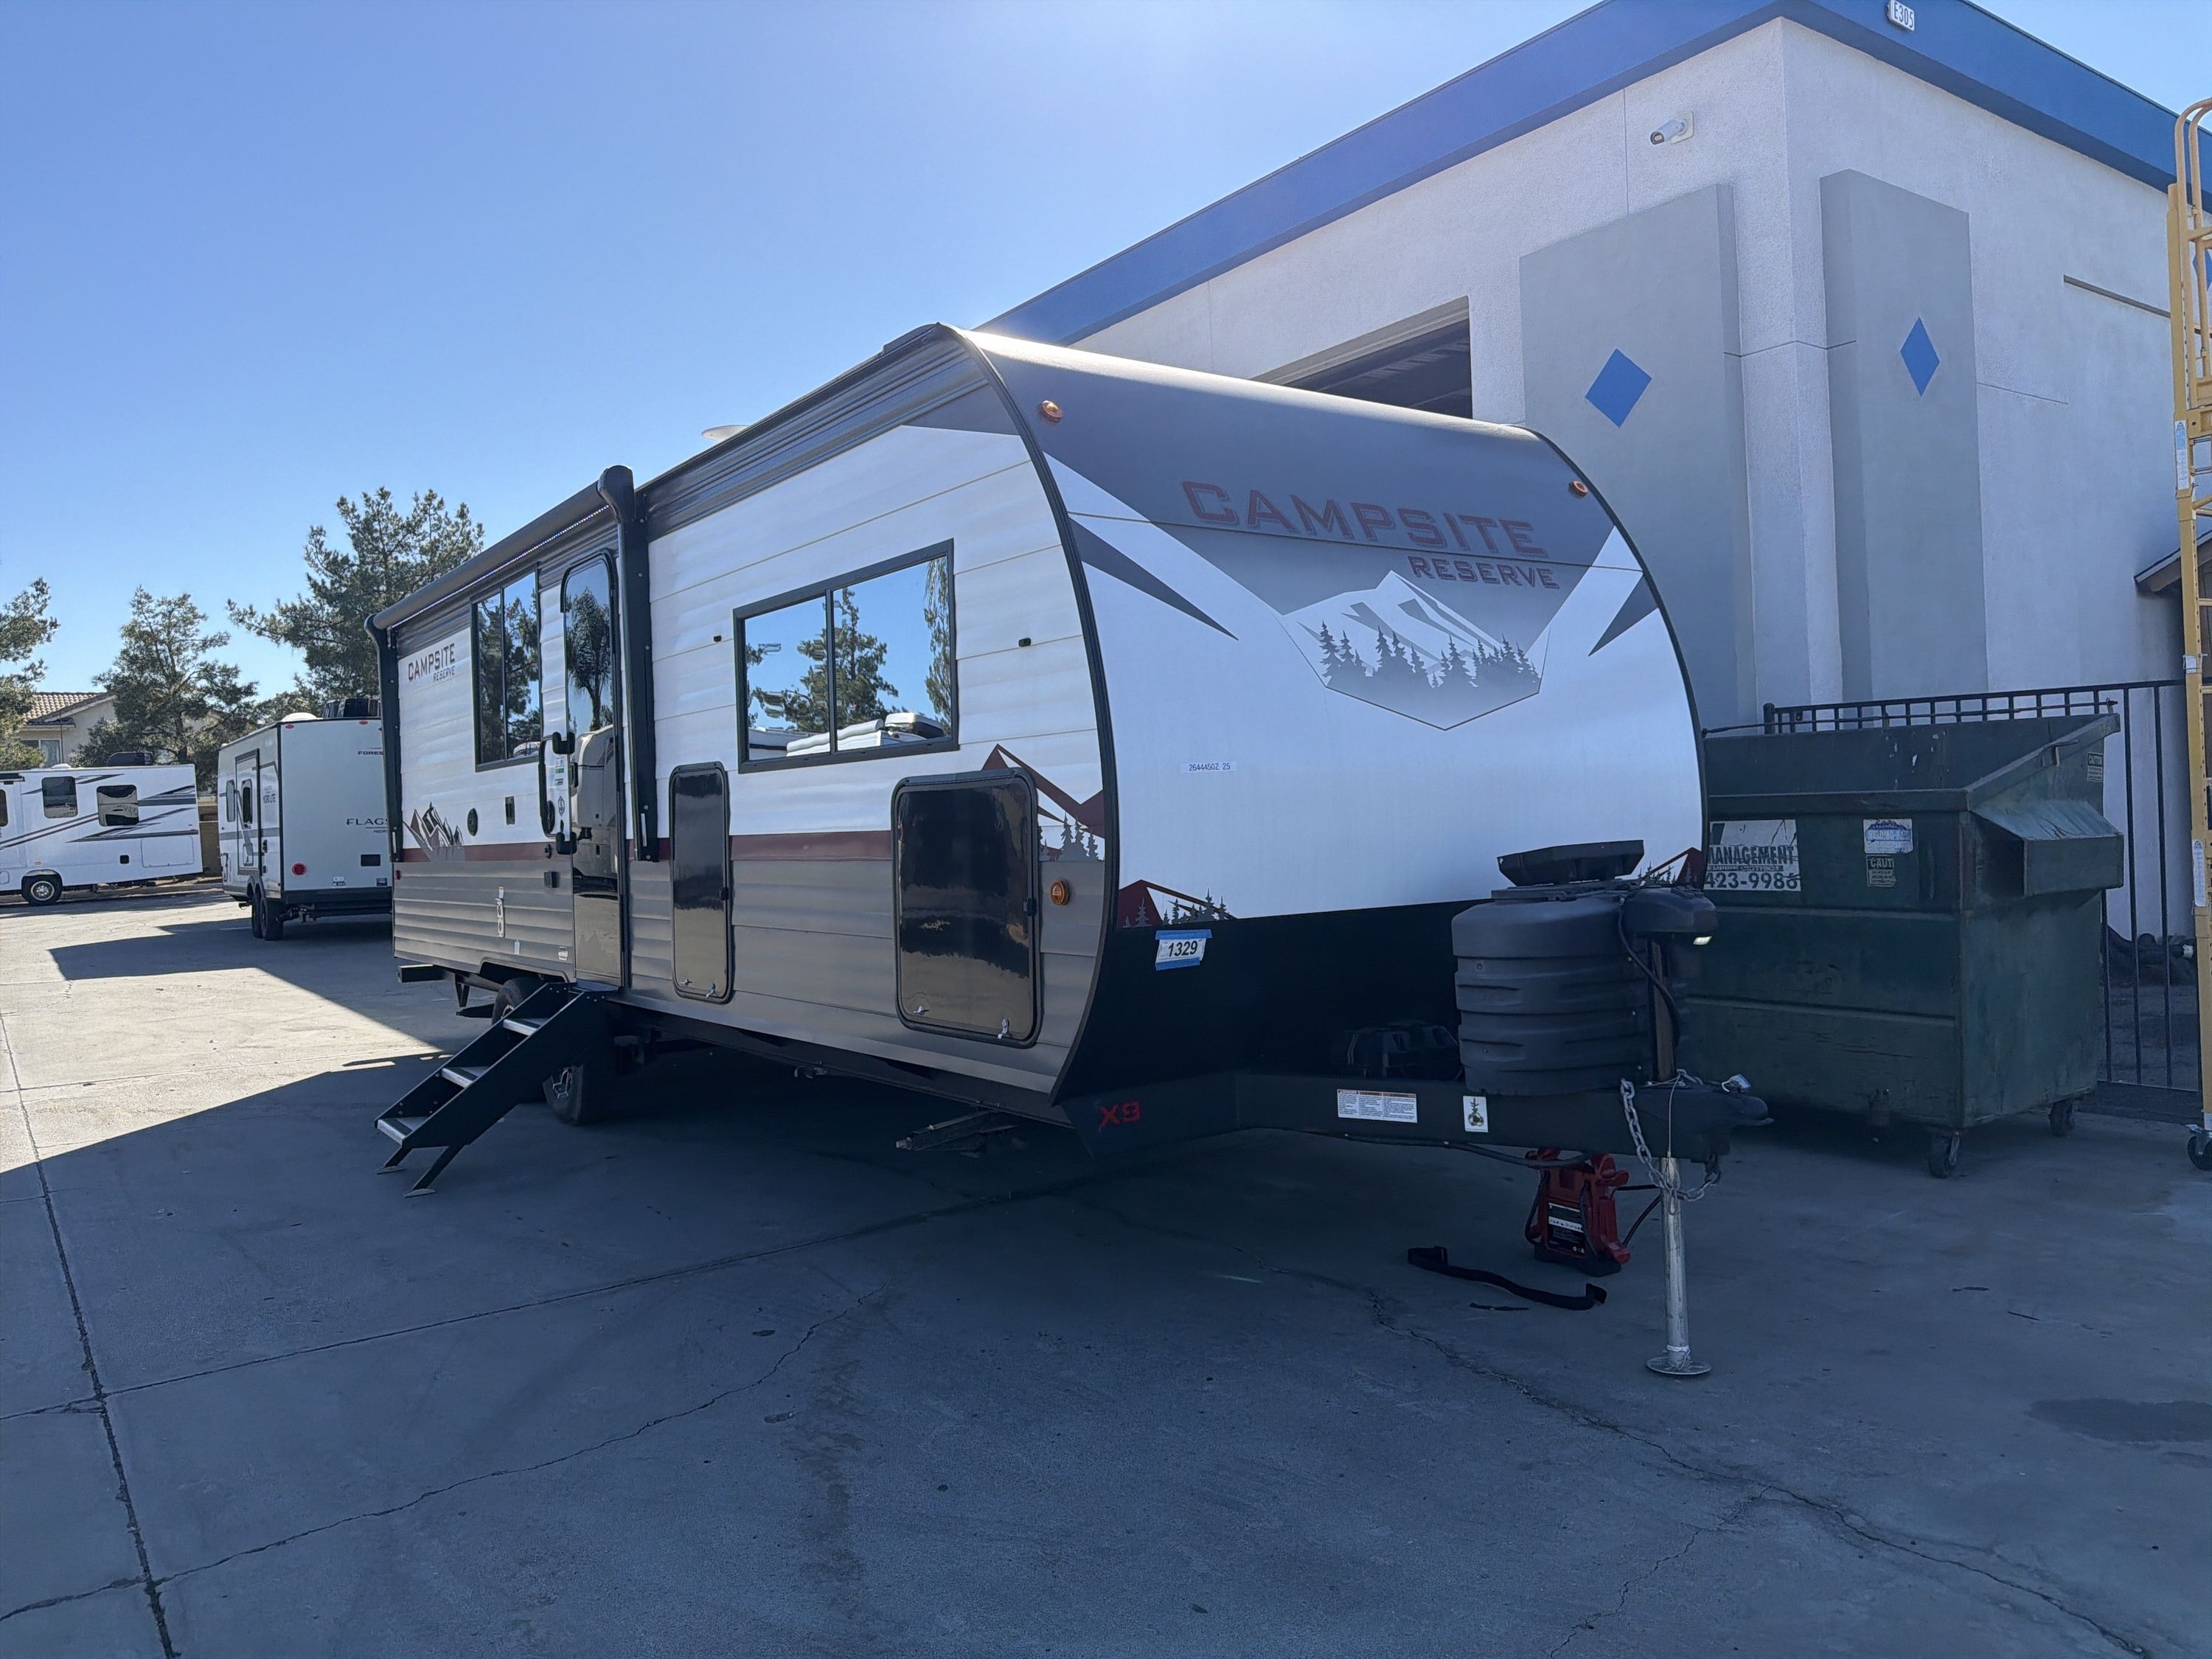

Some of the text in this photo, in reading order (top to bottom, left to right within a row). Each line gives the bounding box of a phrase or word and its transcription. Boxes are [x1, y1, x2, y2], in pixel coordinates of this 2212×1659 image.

[1894, 1, 1913, 28] E305
[1181, 481, 1547, 556] CAMPSITE
[1406, 555, 1559, 589] RESERVE
[408, 643, 456, 682] CAMPSITE
[433, 665, 456, 683] RESERVE
[1222, 762, 1231, 771] 25
[1870, 858, 1893, 868] CAUT
[1168, 940, 1198, 957] 1329
[1098, 1100, 1141, 1129] X9
